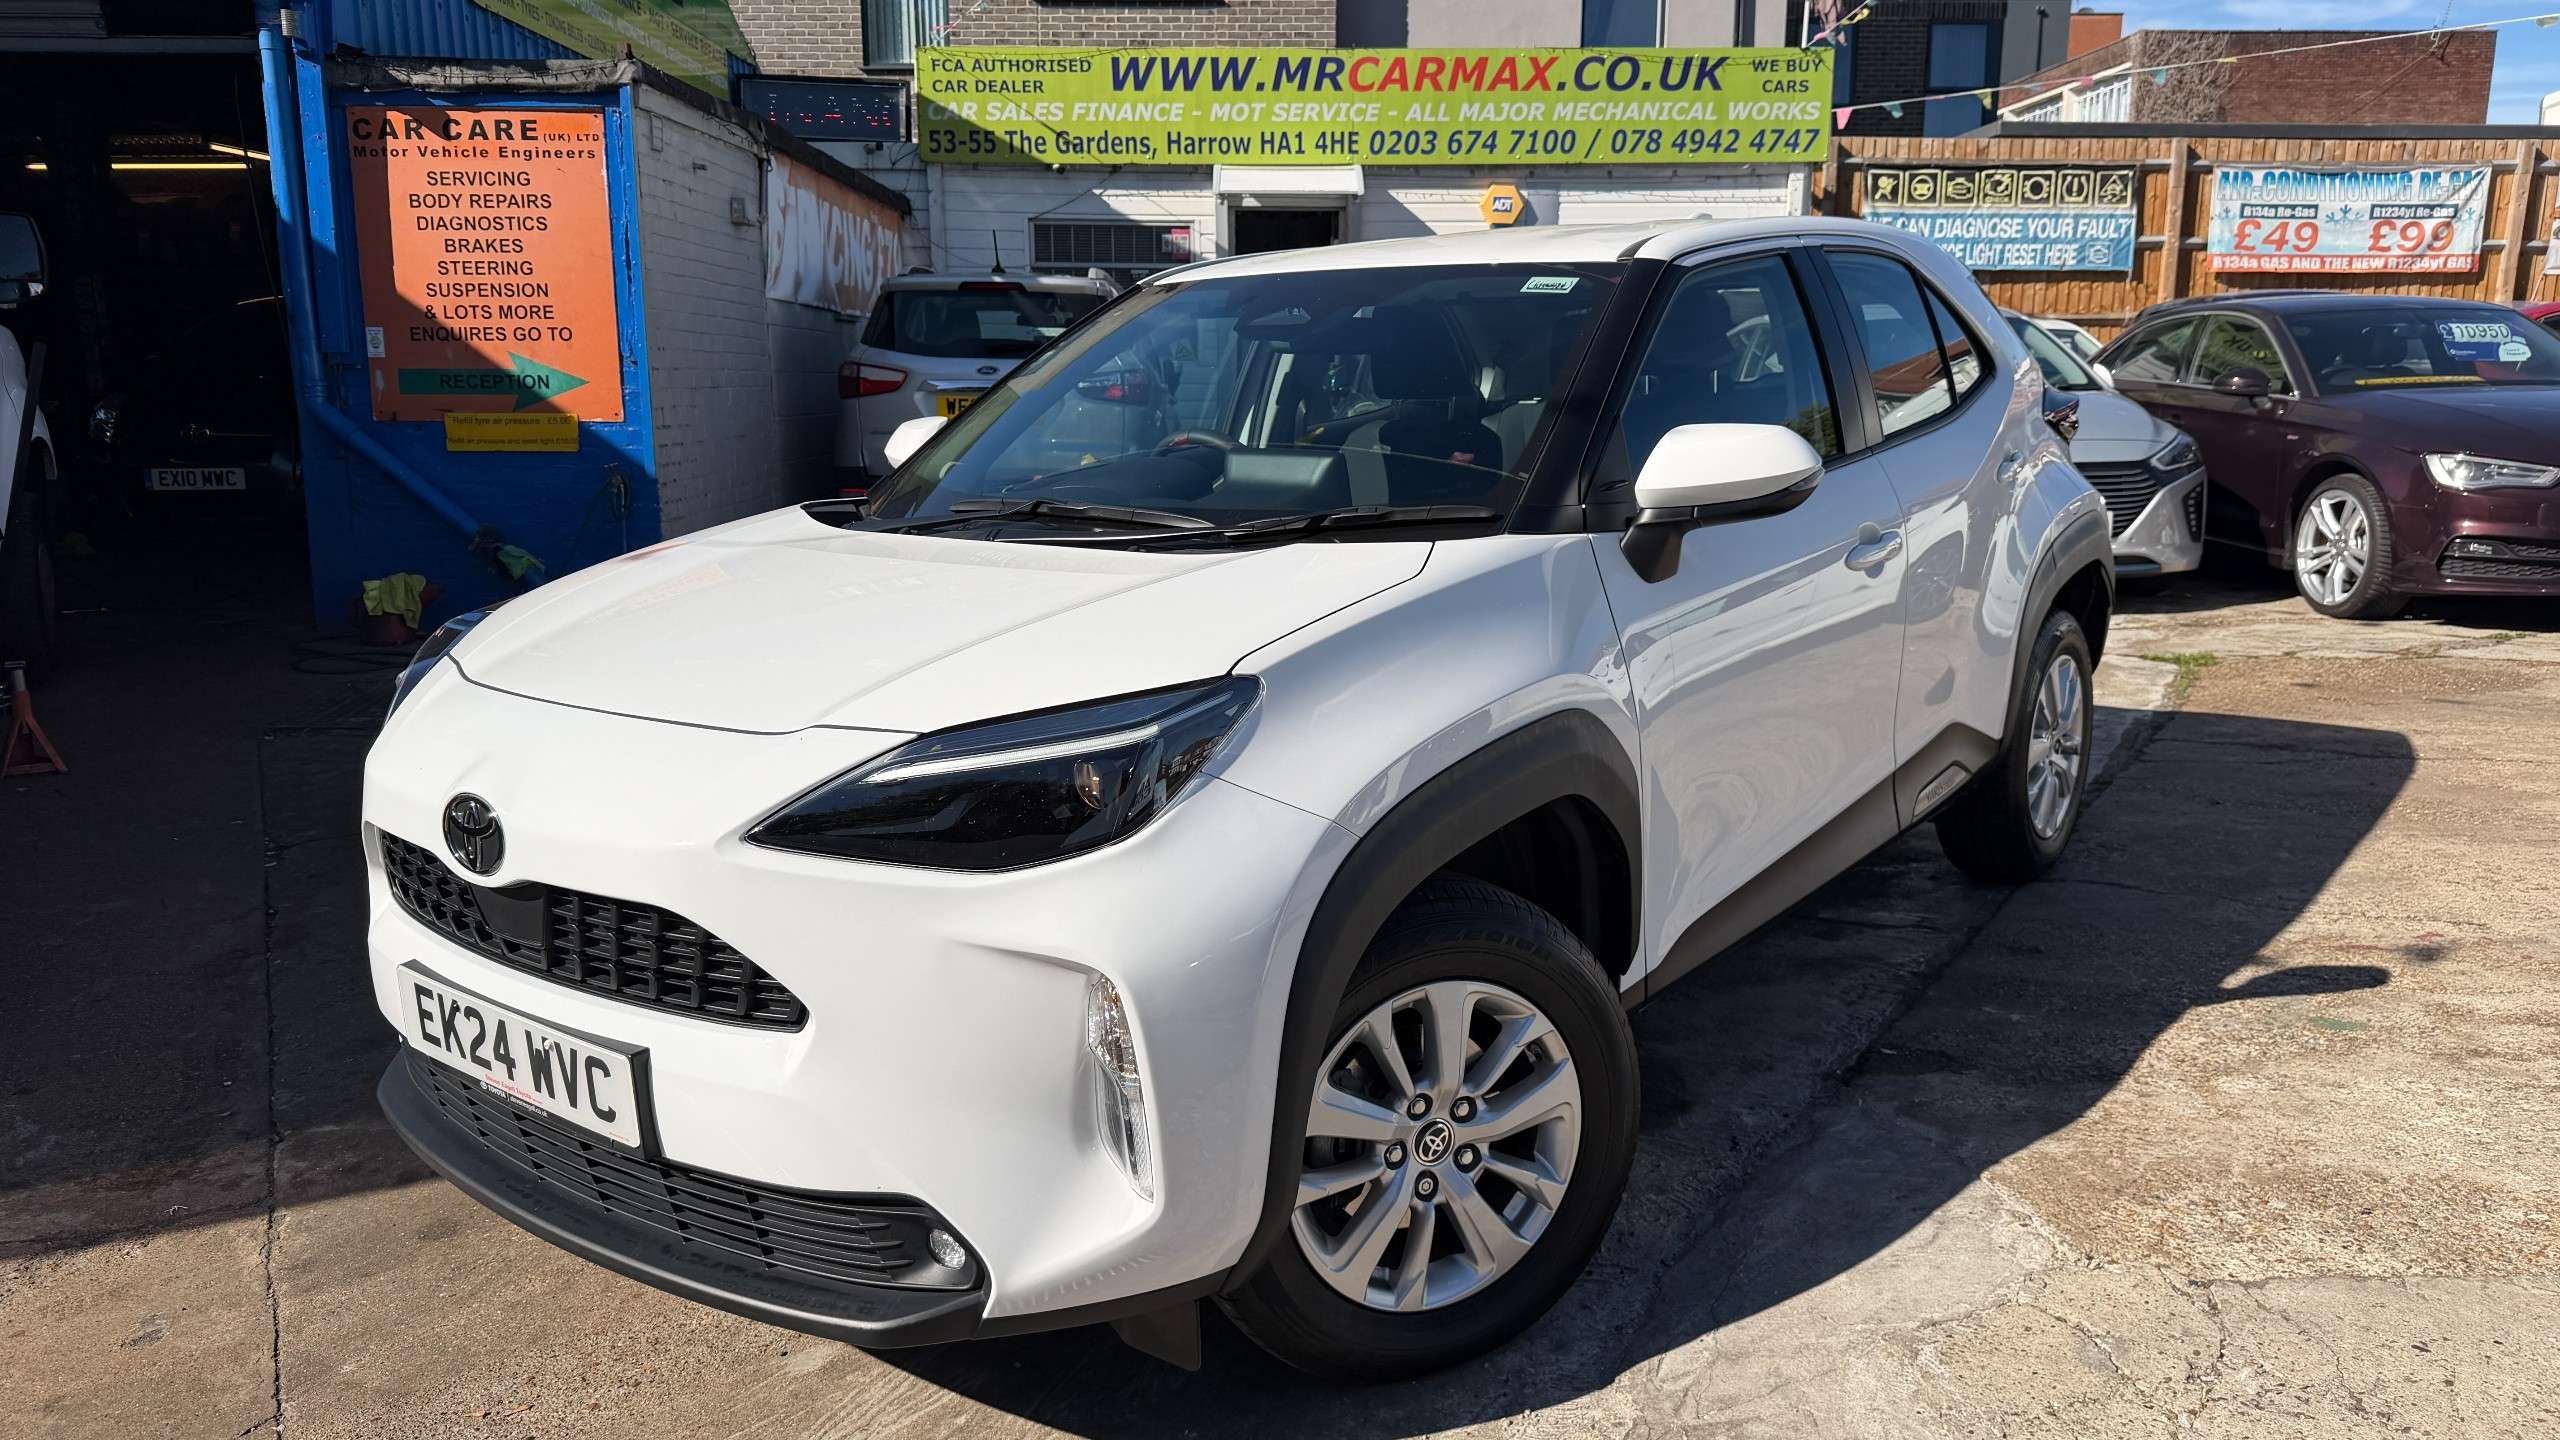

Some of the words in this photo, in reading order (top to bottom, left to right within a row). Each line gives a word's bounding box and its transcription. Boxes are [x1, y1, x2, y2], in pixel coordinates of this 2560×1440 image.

[931, 59, 967, 73] FCA
[971, 58, 1093, 74] AUTHORISED
[1111, 55, 1730, 92] WWW.MRCARMAX.CO.UK
[1752, 59, 1783, 73] WE
[1786, 59, 1823, 73] BUY
[932, 80, 968, 93] CAR
[975, 80, 1044, 93] DEALER
[1762, 80, 1809, 93] CARS
[928, 103, 978, 122] CAR
[984, 102, 1063, 122] SALES
[1071, 102, 1184, 122] FINANCE
[1209, 102, 1266, 122] MOT
[1271, 102, 1379, 122] SERVICE
[1405, 102, 1455, 121] ALL
[1458, 102, 1546, 121] MAJOR
[1552, 102, 1719, 121] MECHANICAL
[1728, 102, 1820, 121] WORKS
[352, 118, 425, 141] CAR
[442, 118, 539, 141] CARE
[543, 133, 571, 143] (UK)
[576, 133, 600, 142] LTD
[928, 129, 997, 155] 53-55
[1004, 130, 1047, 155] The
[1054, 130, 1159, 160] Gardens,
[1166, 131, 1251, 155] Harrow
[1259, 131, 1306, 155] HA1
[1314, 130, 1360, 155] 4HE
[1369, 130, 1437, 155] 0203
[1447, 130, 1498, 155] 674
[1508, 130, 1576, 155] 7100
[1583, 128, 1601, 159] /
[1610, 130, 1662, 154] 078
[1671, 129, 1740, 154] 4942
[1749, 129, 1820, 154] 4747
[353, 146, 408, 158] Motor
[417, 146, 489, 158] Vehicle
[499, 146, 596, 161] Engineers
[427, 171, 531, 186] SERVICING
[409, 194, 462, 209] BODY
[469, 194, 552, 209] REPAIRS
[2243, 206, 2276, 217] R134a
[416, 216, 548, 231] DIAGNOSTICS
[1896, 216, 1932, 238] CAN
[1934, 217, 2024, 239] DIAGNOSE
[2027, 218, 2074, 239] YOUR
[2077, 218, 2133, 239] FAULT
[2233, 219, 2319, 253] £49
[2368, 219, 2454, 253] £99
[444, 238, 524, 253] BRAKES
[1965, 243, 2001, 266] LIGHT
[2005, 243, 2041, 265] RESET
[2044, 243, 2078, 265] HERE
[437, 260, 534, 276] STEERING
[2260, 256, 2290, 270] GAS
[2291, 256, 2321, 270] AND
[2324, 256, 2351, 270] THE
[2352, 256, 2385, 270] NEW
[425, 282, 549, 298] SUSPENSION
[424, 305, 437, 320] &
[443, 304, 492, 320] LOTS
[499, 304, 554, 320] MORE
[410, 326, 508, 343] ENQUIRES
[513, 326, 542, 342] GO
[547, 326, 573, 342] TO
[439, 374, 550, 390] RECEPTION
[946, 397, 977, 415] WE
[414, 982, 516, 1082] EK24
[524, 1029, 617, 1123] WVC
